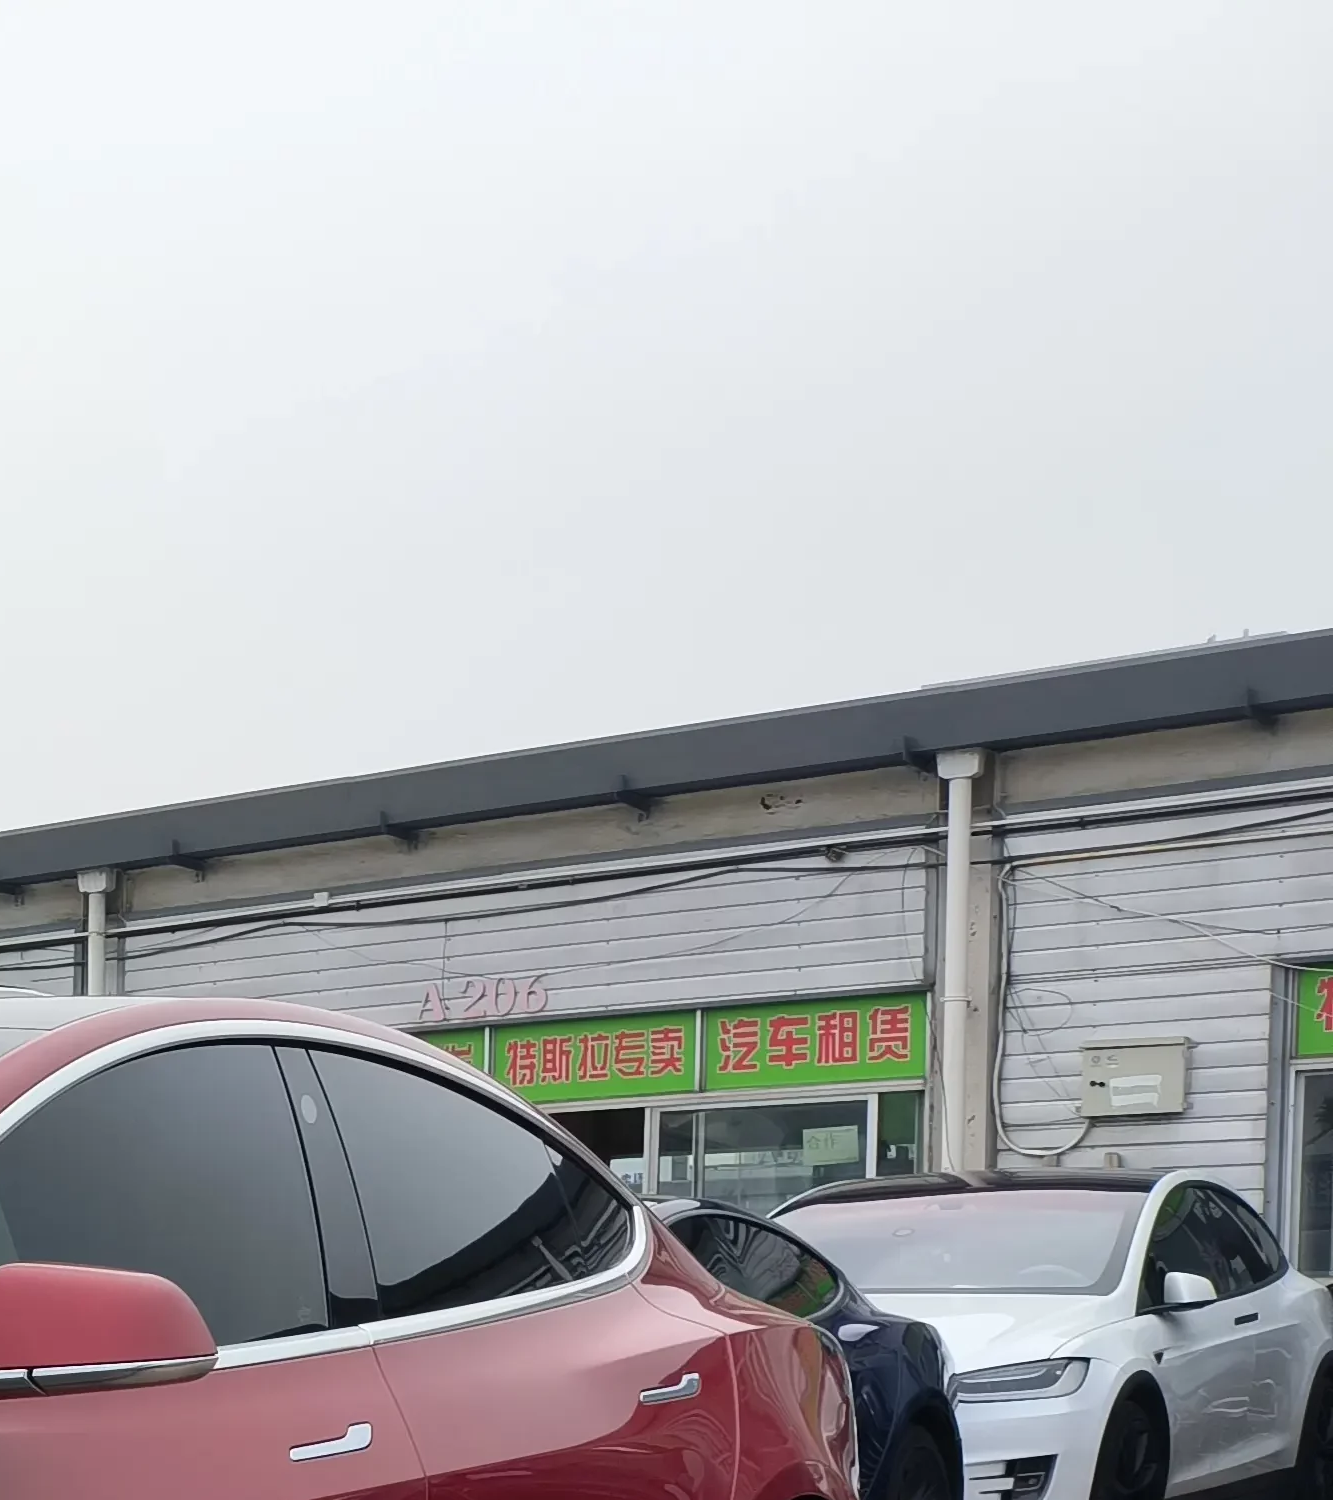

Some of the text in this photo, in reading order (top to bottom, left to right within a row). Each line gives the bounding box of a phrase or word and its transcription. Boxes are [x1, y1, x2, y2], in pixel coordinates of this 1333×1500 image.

[505, 1025, 685, 1088] 特斯拉专卖
[717, 1003, 912, 1074] 汽车租赁
